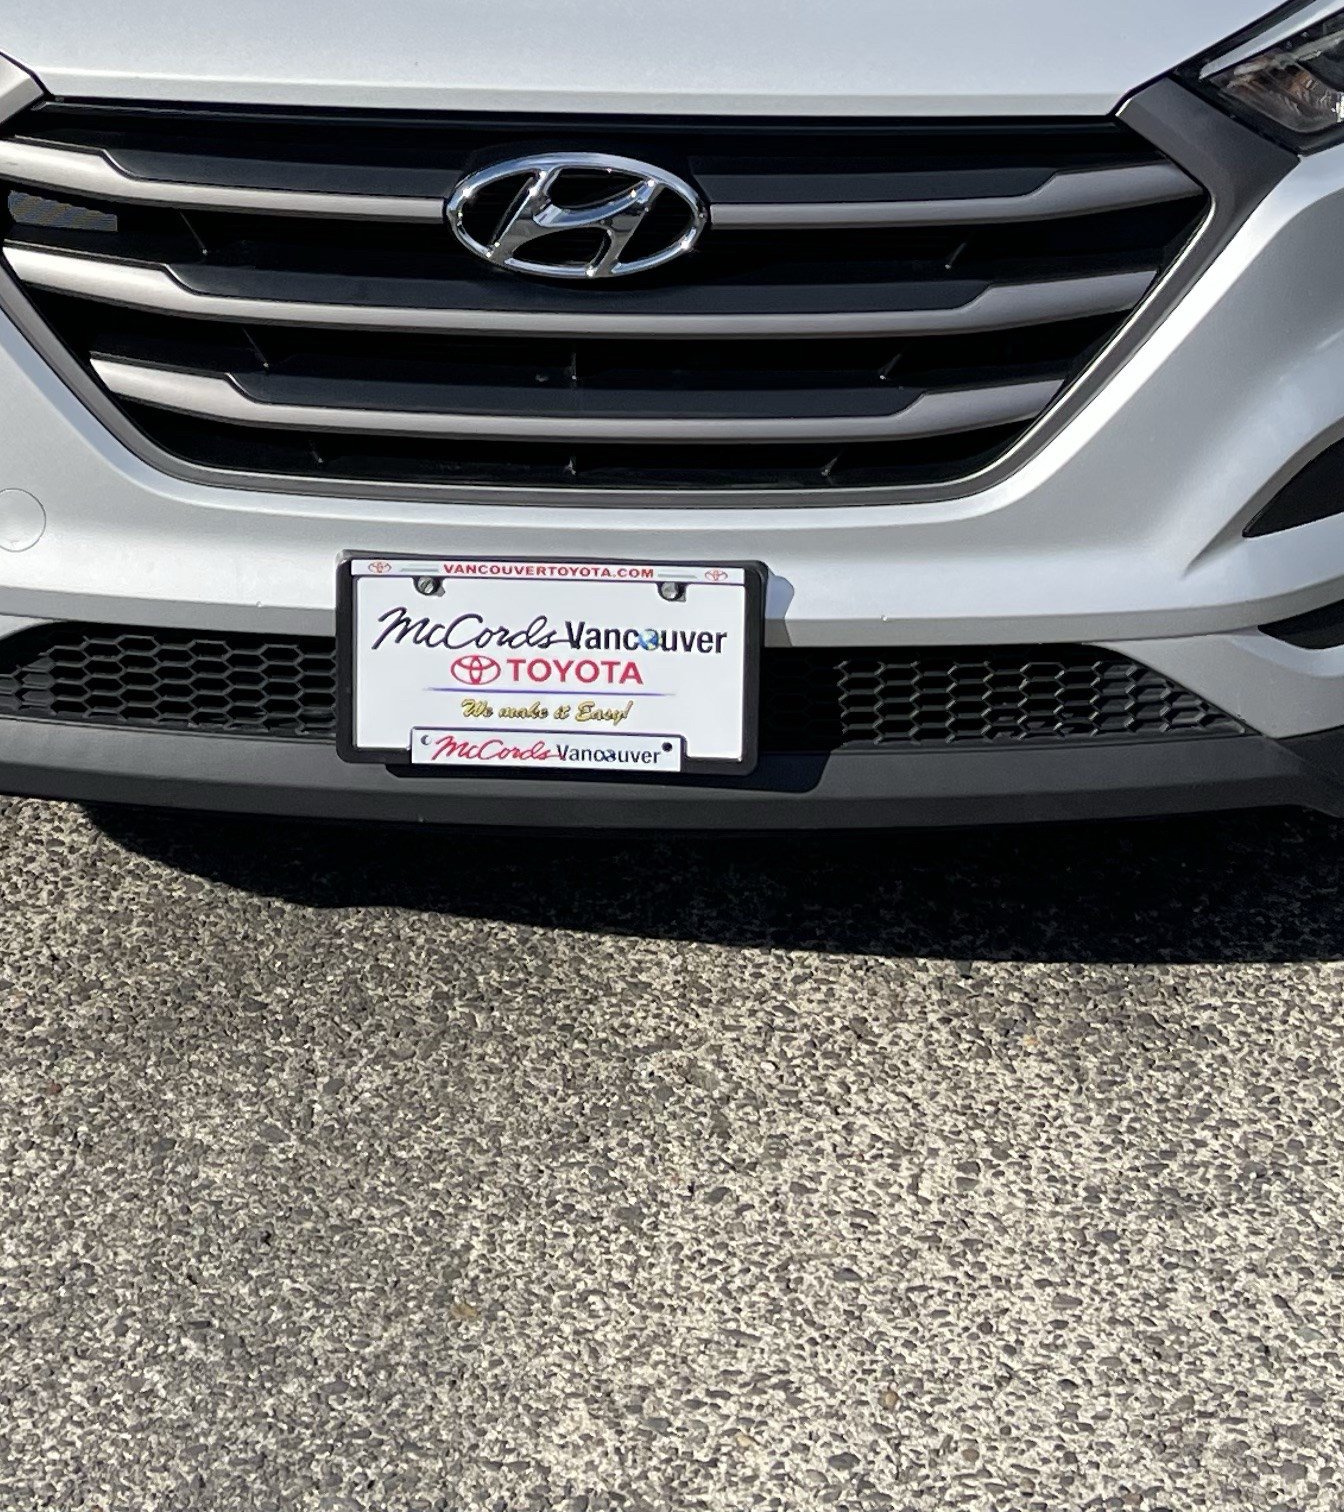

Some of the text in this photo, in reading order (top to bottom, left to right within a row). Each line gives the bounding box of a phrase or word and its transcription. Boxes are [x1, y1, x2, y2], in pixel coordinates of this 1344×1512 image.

[443, 563, 654, 579] VANCOUVERTOYOTA.COM
[507, 659, 644, 685] TOYOTA
[461, 699, 493, 718] We
[498, 701, 548, 719] make
[575, 701, 634, 726] Easy!
